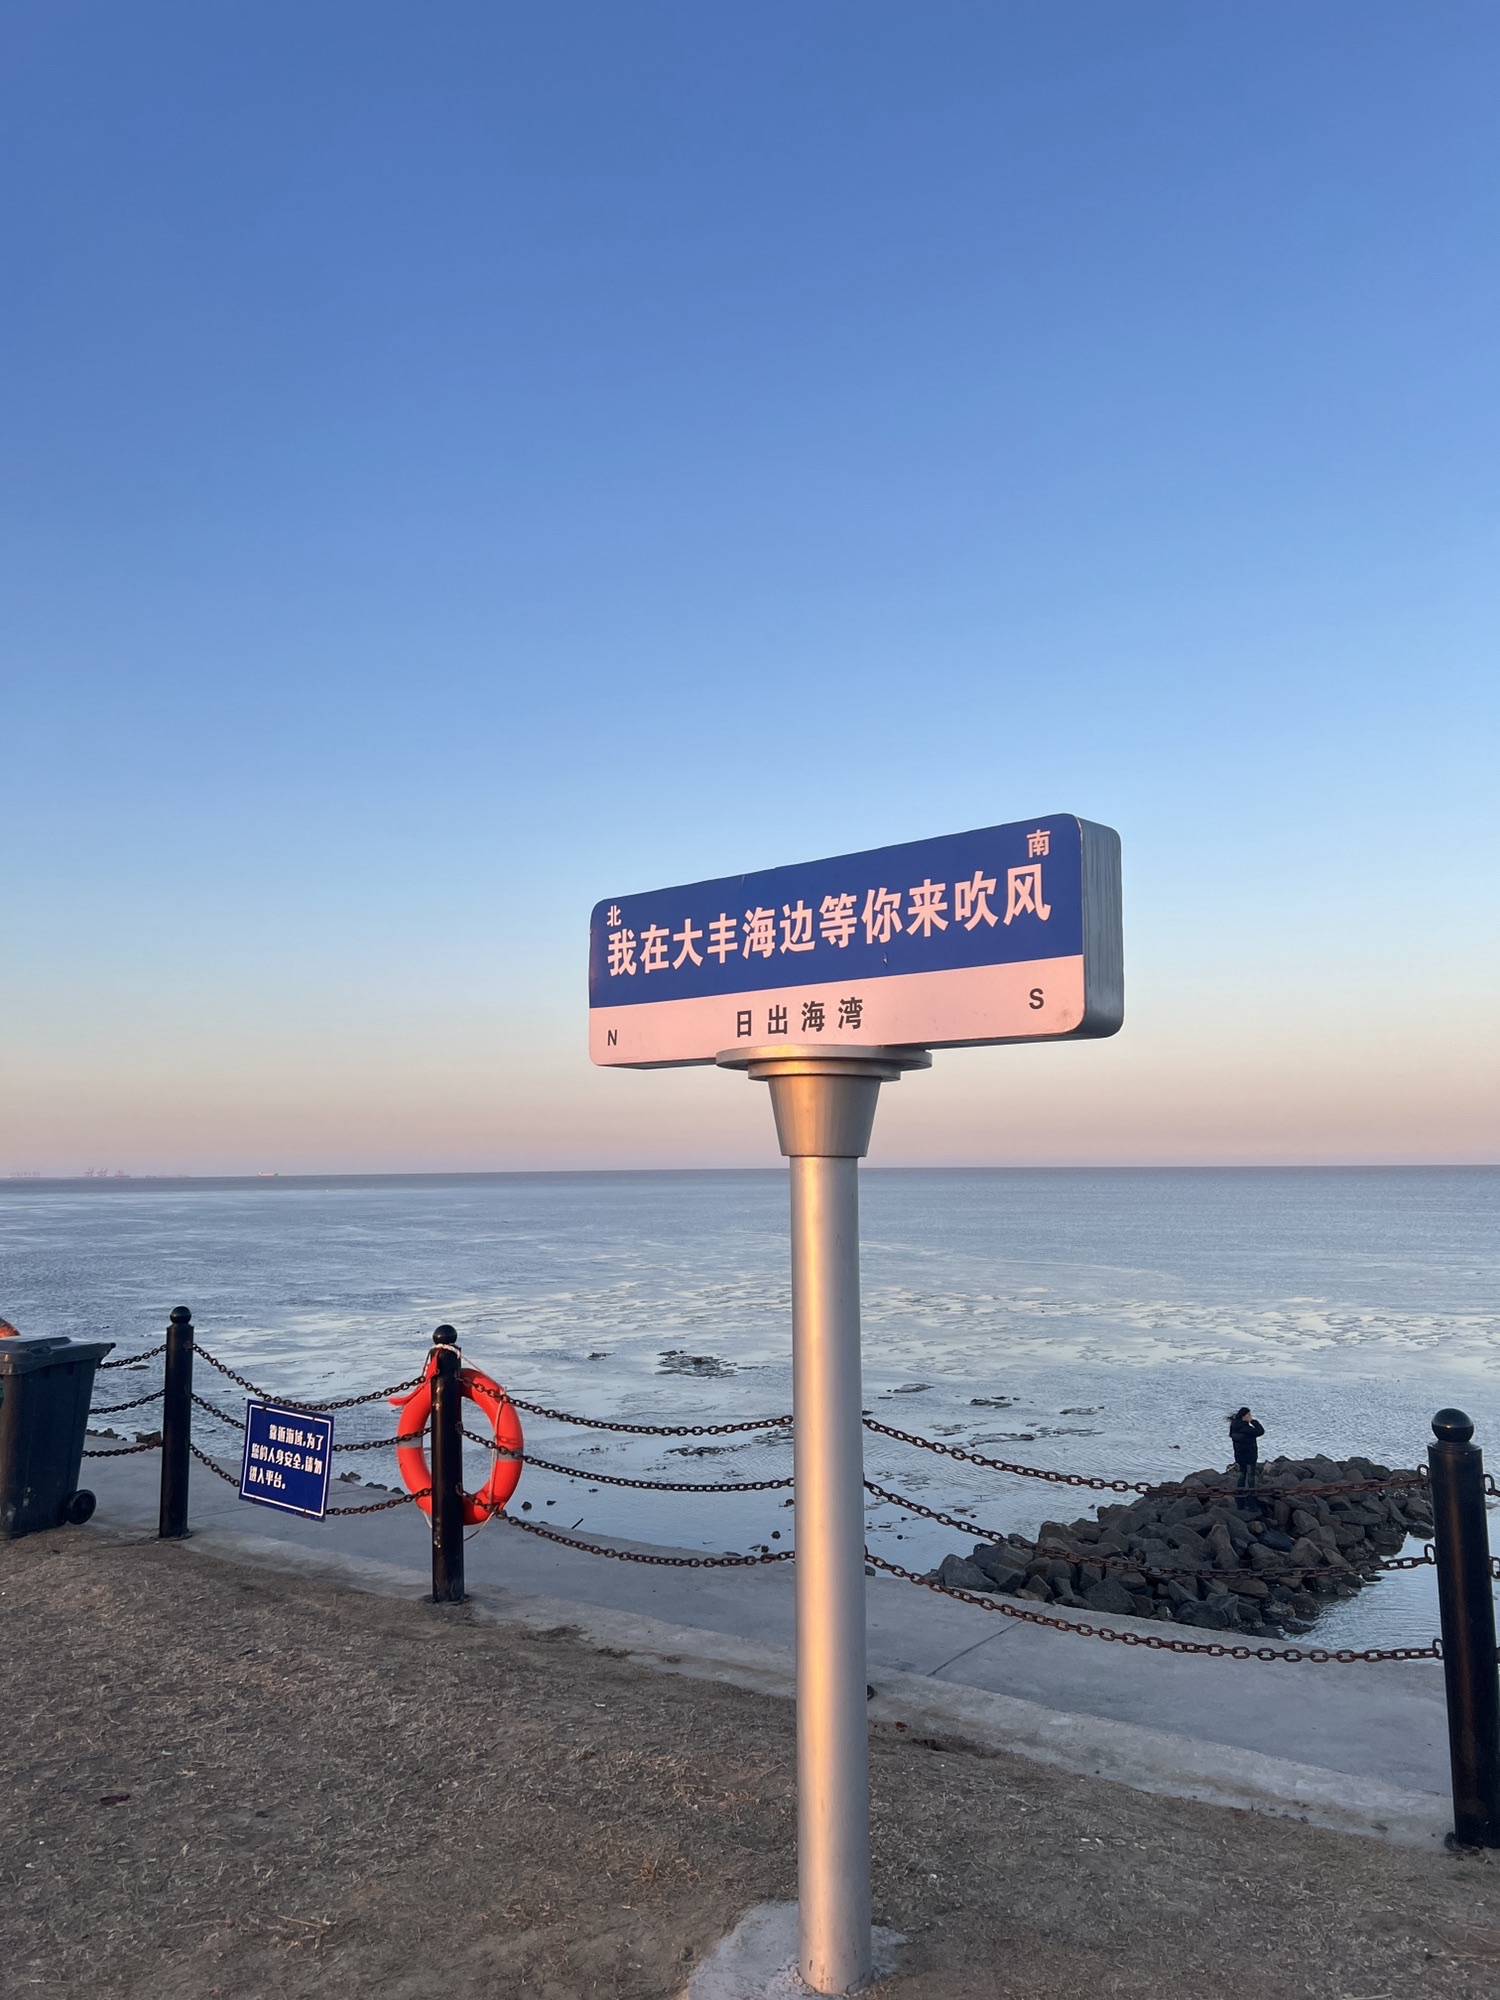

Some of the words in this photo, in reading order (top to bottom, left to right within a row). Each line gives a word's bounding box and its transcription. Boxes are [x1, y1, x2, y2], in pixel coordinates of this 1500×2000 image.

[1027, 829, 1051, 858] 南
[607, 905, 622, 927] 北
[607, 863, 1052, 977] 我在大丰海边等你来吹风
[1029, 987, 1044, 1010] S
[736, 997, 864, 1038] 日出海湾
[607, 1029, 617, 1046] N
